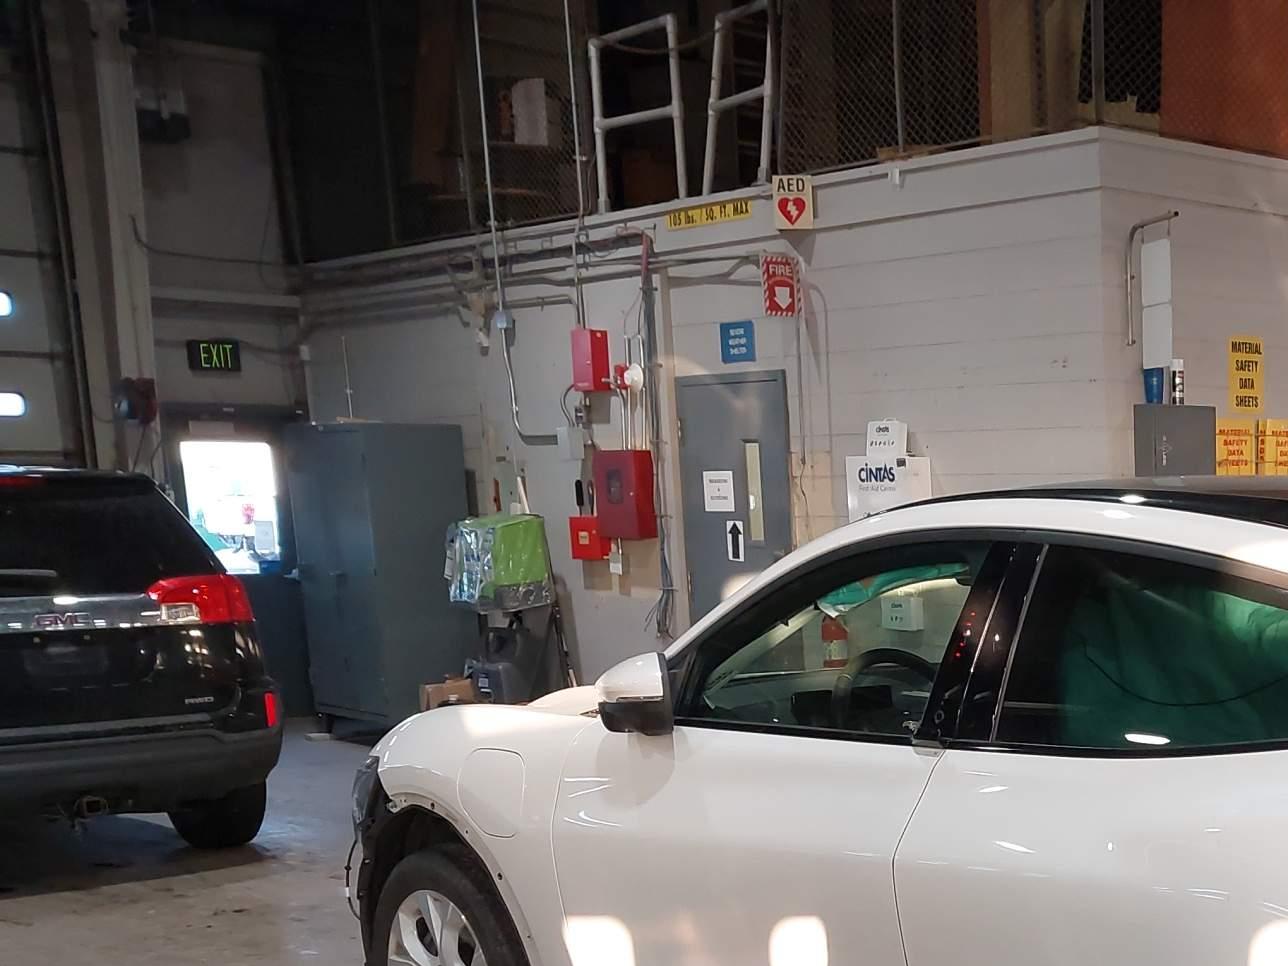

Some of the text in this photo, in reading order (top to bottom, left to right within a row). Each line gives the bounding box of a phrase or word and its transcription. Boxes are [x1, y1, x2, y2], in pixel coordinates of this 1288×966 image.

[777, 178, 805, 193] AED
[669, 213, 682, 228] 105
[685, 211, 697, 225] lbs.
[705, 207, 717, 221] SQ.
[719, 203, 730, 218] FT.
[732, 200, 750, 216] MAX
[768, 264, 793, 276] FIRE
[1231, 341, 1262, 355] MATERIAL
[200, 344, 232, 369] EXIT
[1235, 359, 1259, 373] SAFETY
[1239, 377, 1255, 390] DATA
[1235, 395, 1259, 408] SHEETS
[1228, 449, 1244, 457] DATA
[35, 612, 90, 628] GMC
